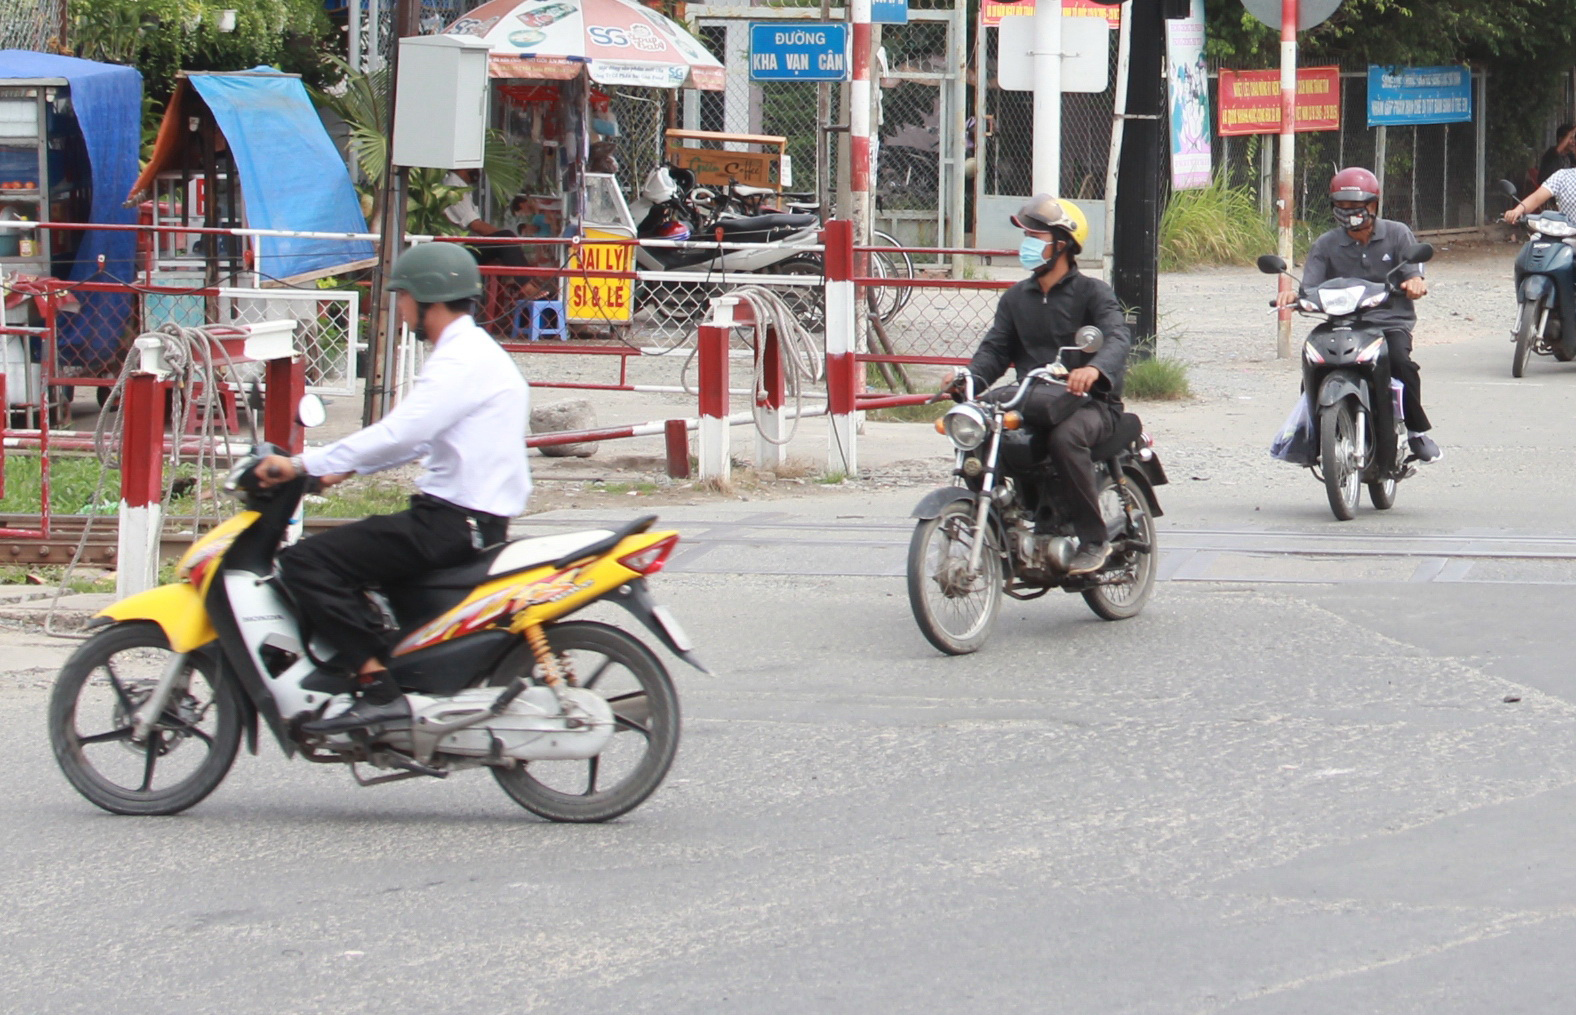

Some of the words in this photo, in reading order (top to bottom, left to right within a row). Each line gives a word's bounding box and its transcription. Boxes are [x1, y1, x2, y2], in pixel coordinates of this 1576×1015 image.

[775, 29, 826, 45] ĐƯỜNG
[753, 53, 778, 71] KHA
[786, 53, 809, 75] VẠN
[818, 50, 843, 71] CÂN
[724, 158, 760, 181] Coffee
[591, 286, 601, 308] &
